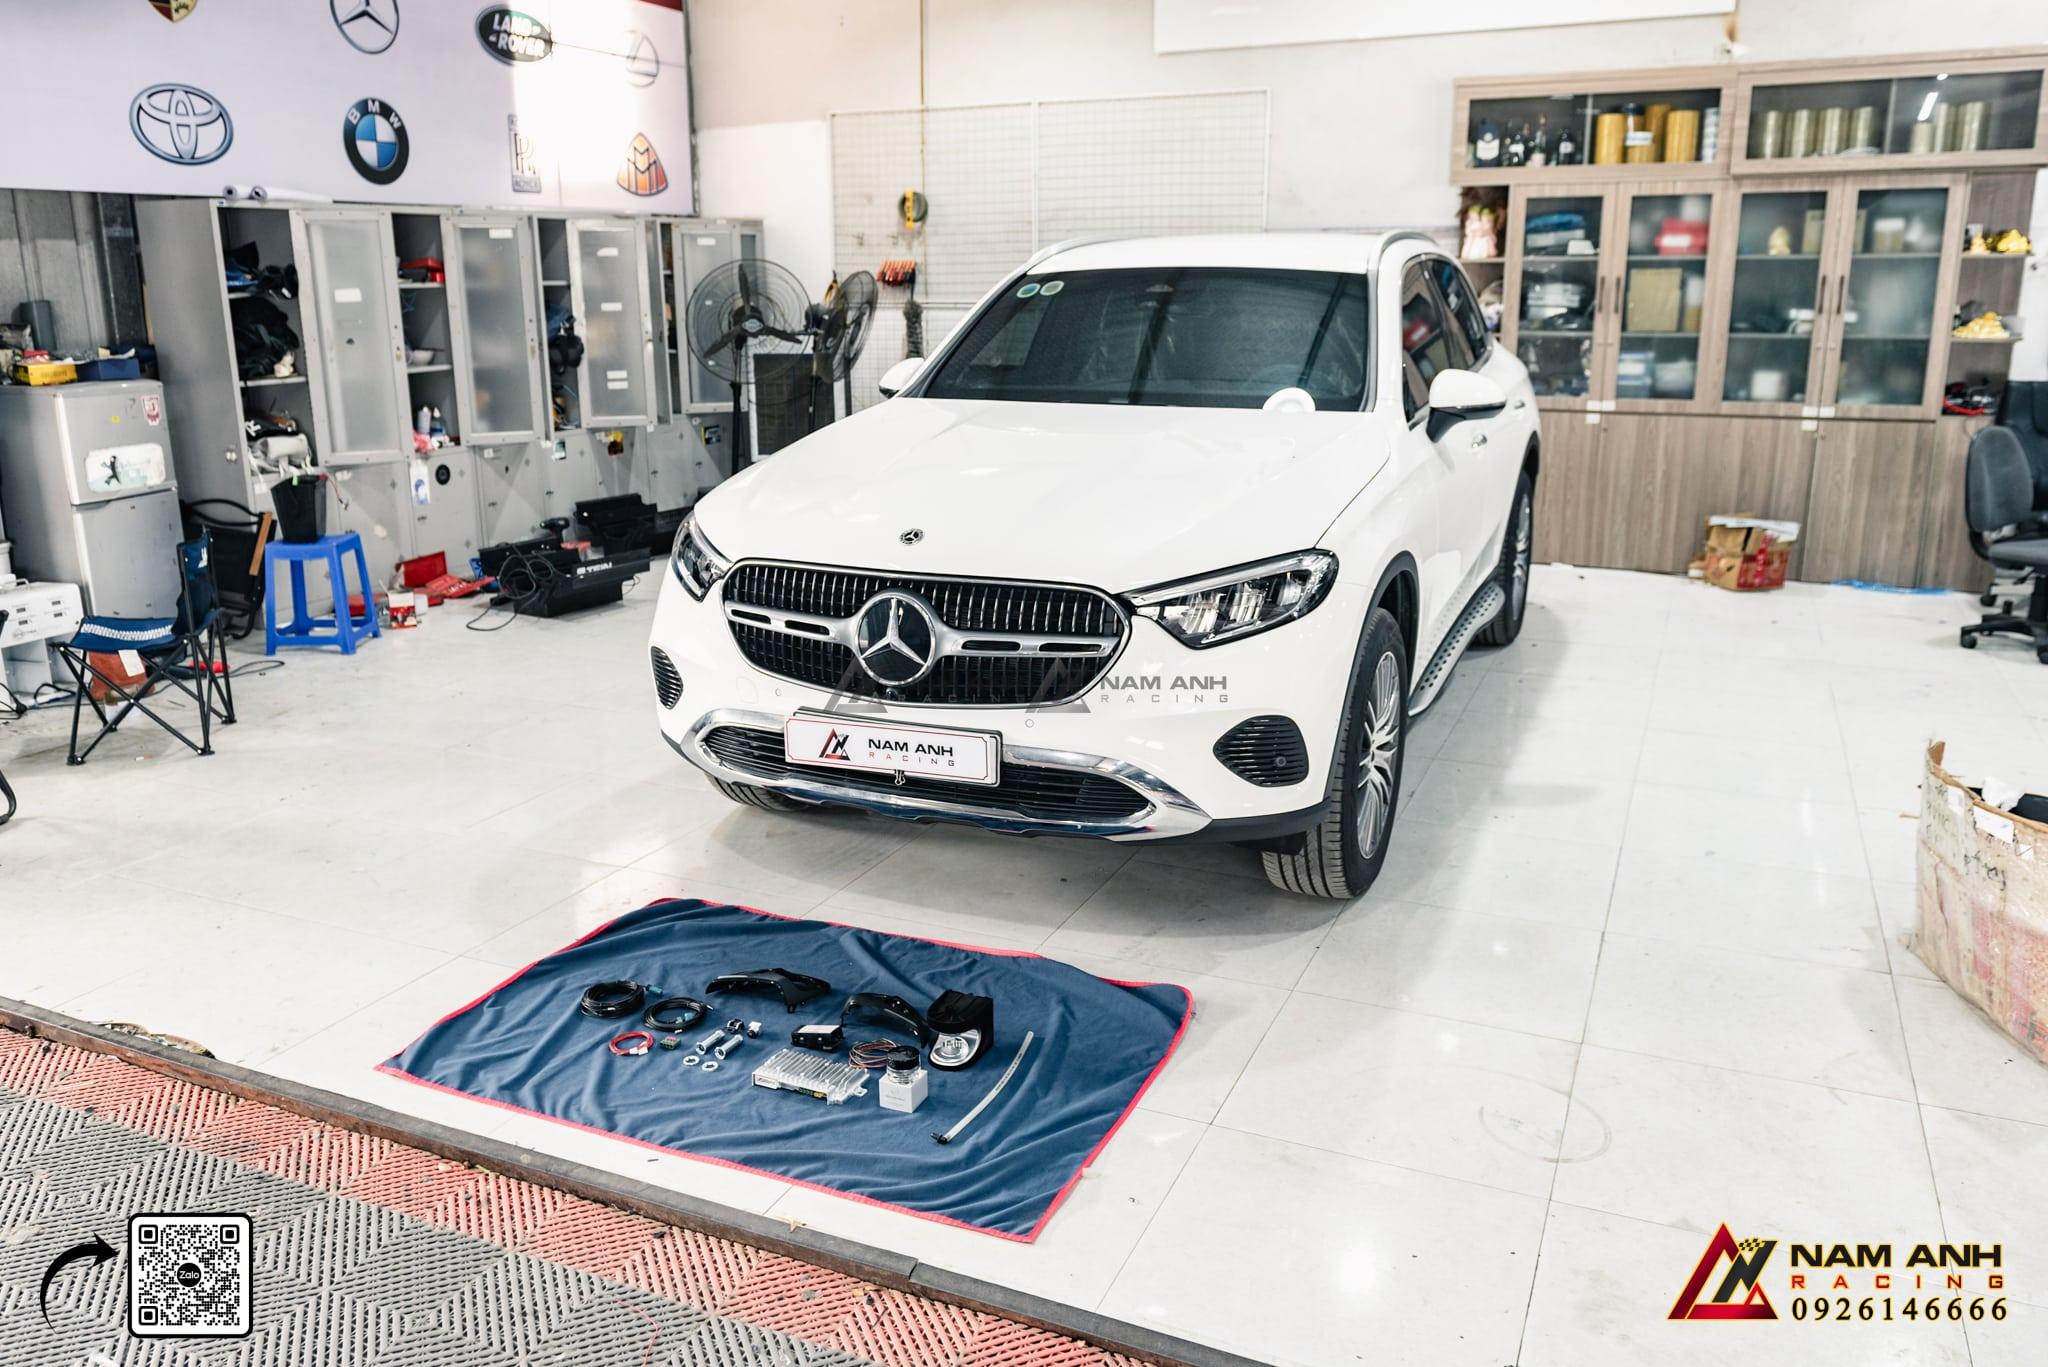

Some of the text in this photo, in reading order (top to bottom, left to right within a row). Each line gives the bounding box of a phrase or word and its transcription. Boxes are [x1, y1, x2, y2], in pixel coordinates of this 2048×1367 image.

[347, 98, 402, 129] BMW
[868, 738, 953, 757] NAM ANH
[868, 752, 955, 767] RACING
